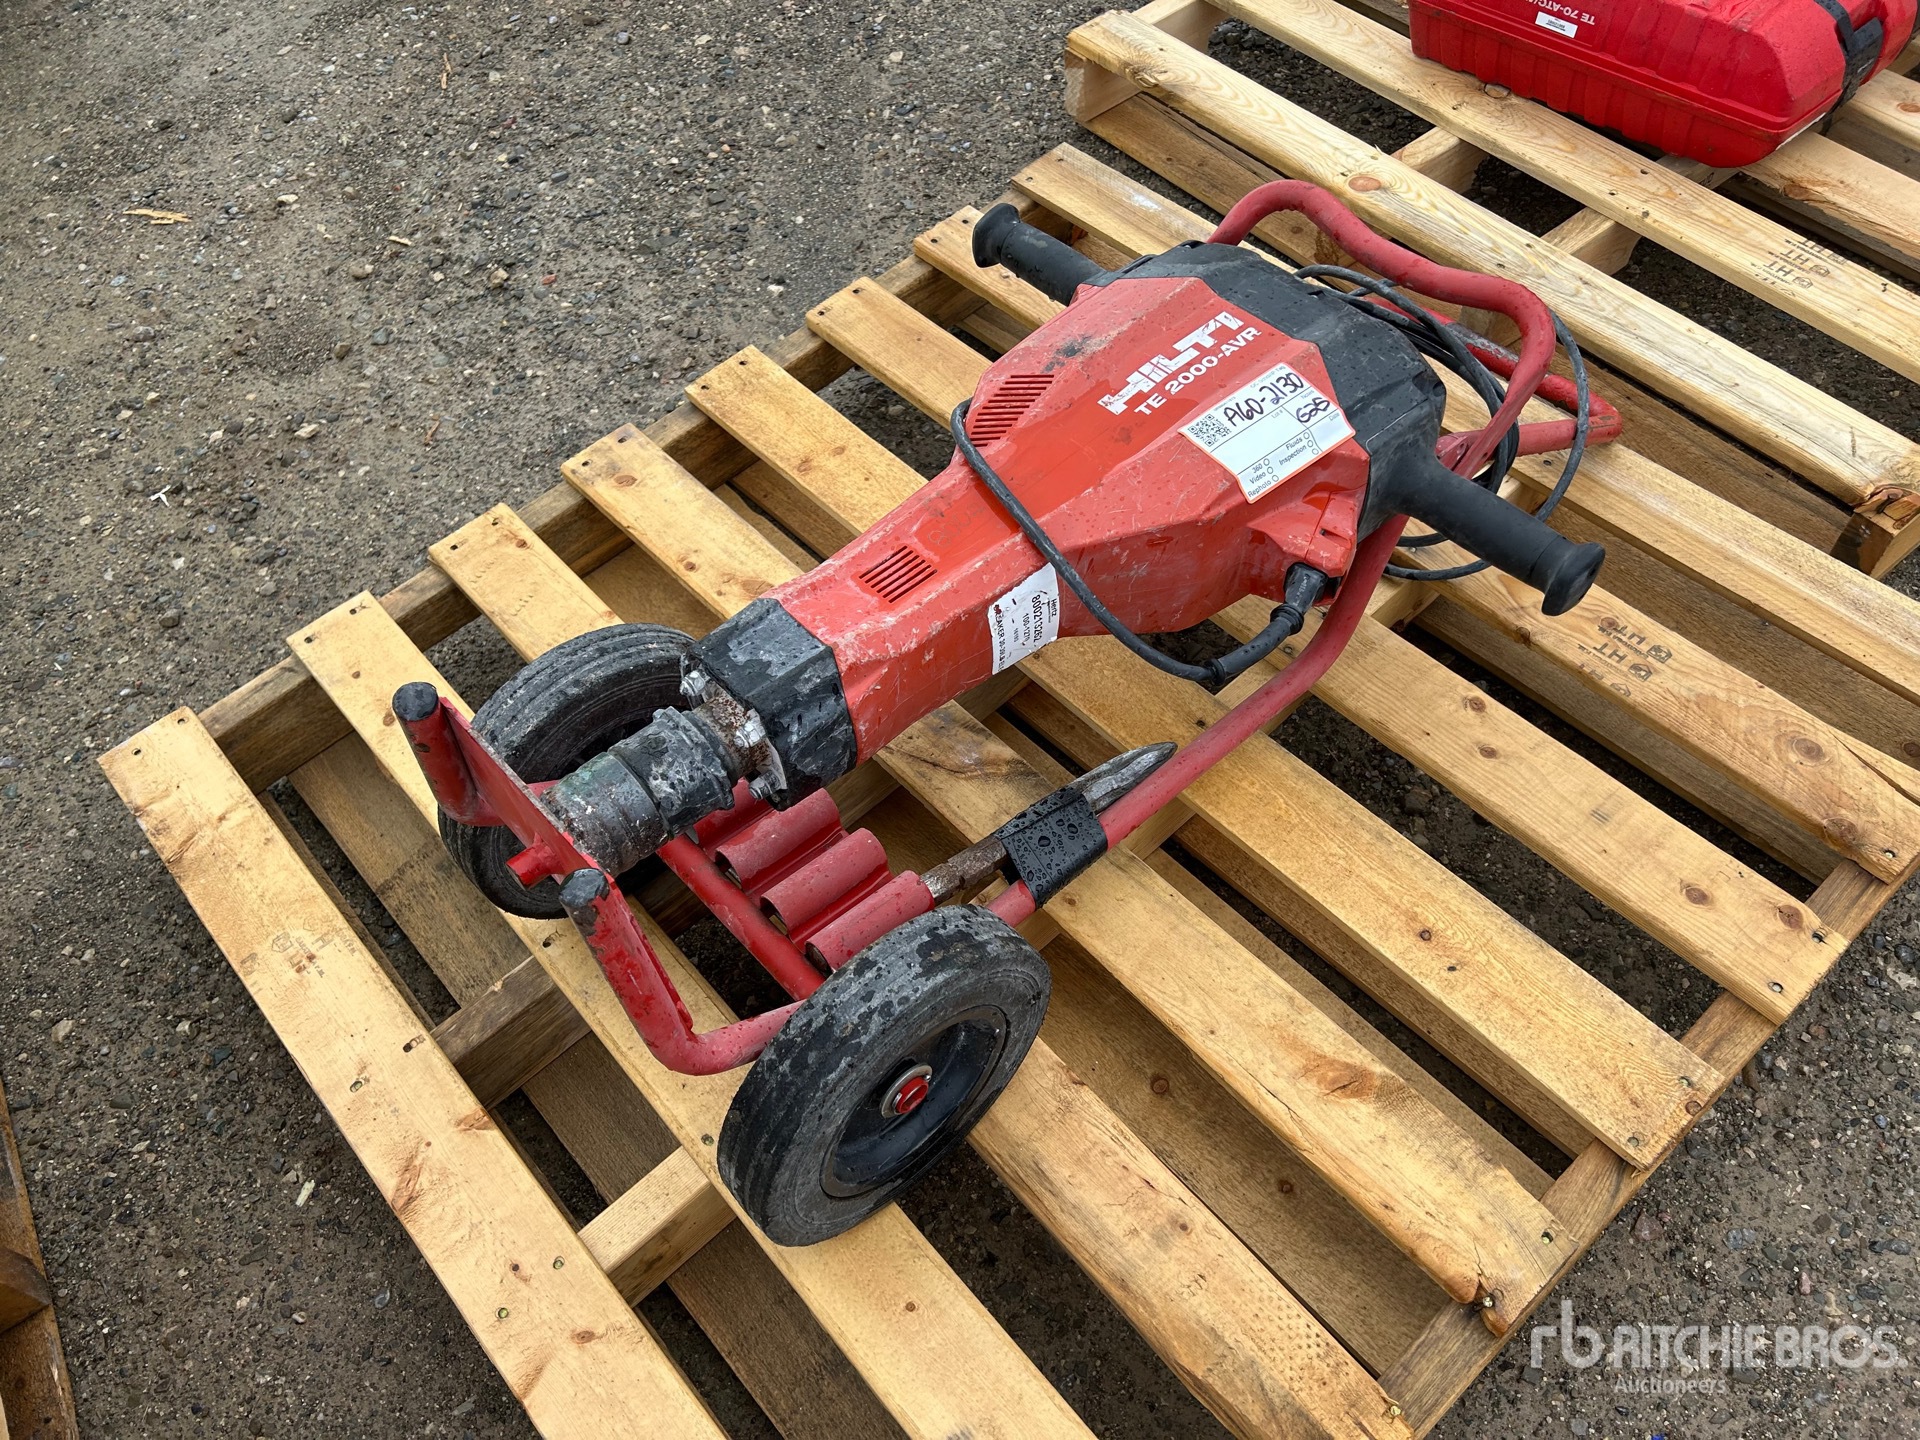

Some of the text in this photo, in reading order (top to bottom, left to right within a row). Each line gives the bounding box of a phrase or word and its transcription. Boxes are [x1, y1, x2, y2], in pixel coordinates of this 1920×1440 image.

[1523, 0, 1579, 19] 70-ATC/
[1580, 12, 1595, 26] TE
[1780, 249, 1810, 265] HT
[1763, 261, 1795, 277] HT
[1097, 311, 1244, 416] HILTI
[1134, 393, 1167, 415] TE
[1165, 327, 1262, 395] 2000-AVR
[1223, 372, 1304, 427] A60-2130
[1285, 437, 1303, 451] Fluids
[1278, 444, 1307, 466] Inspection
[1252, 463, 1263, 474] 360
[1249, 471, 1267, 485] Video
[1247, 480, 1272, 498] Rephoto
[1031, 594, 1043, 643] 800213262
[1592, 641, 1628, 663] HT
